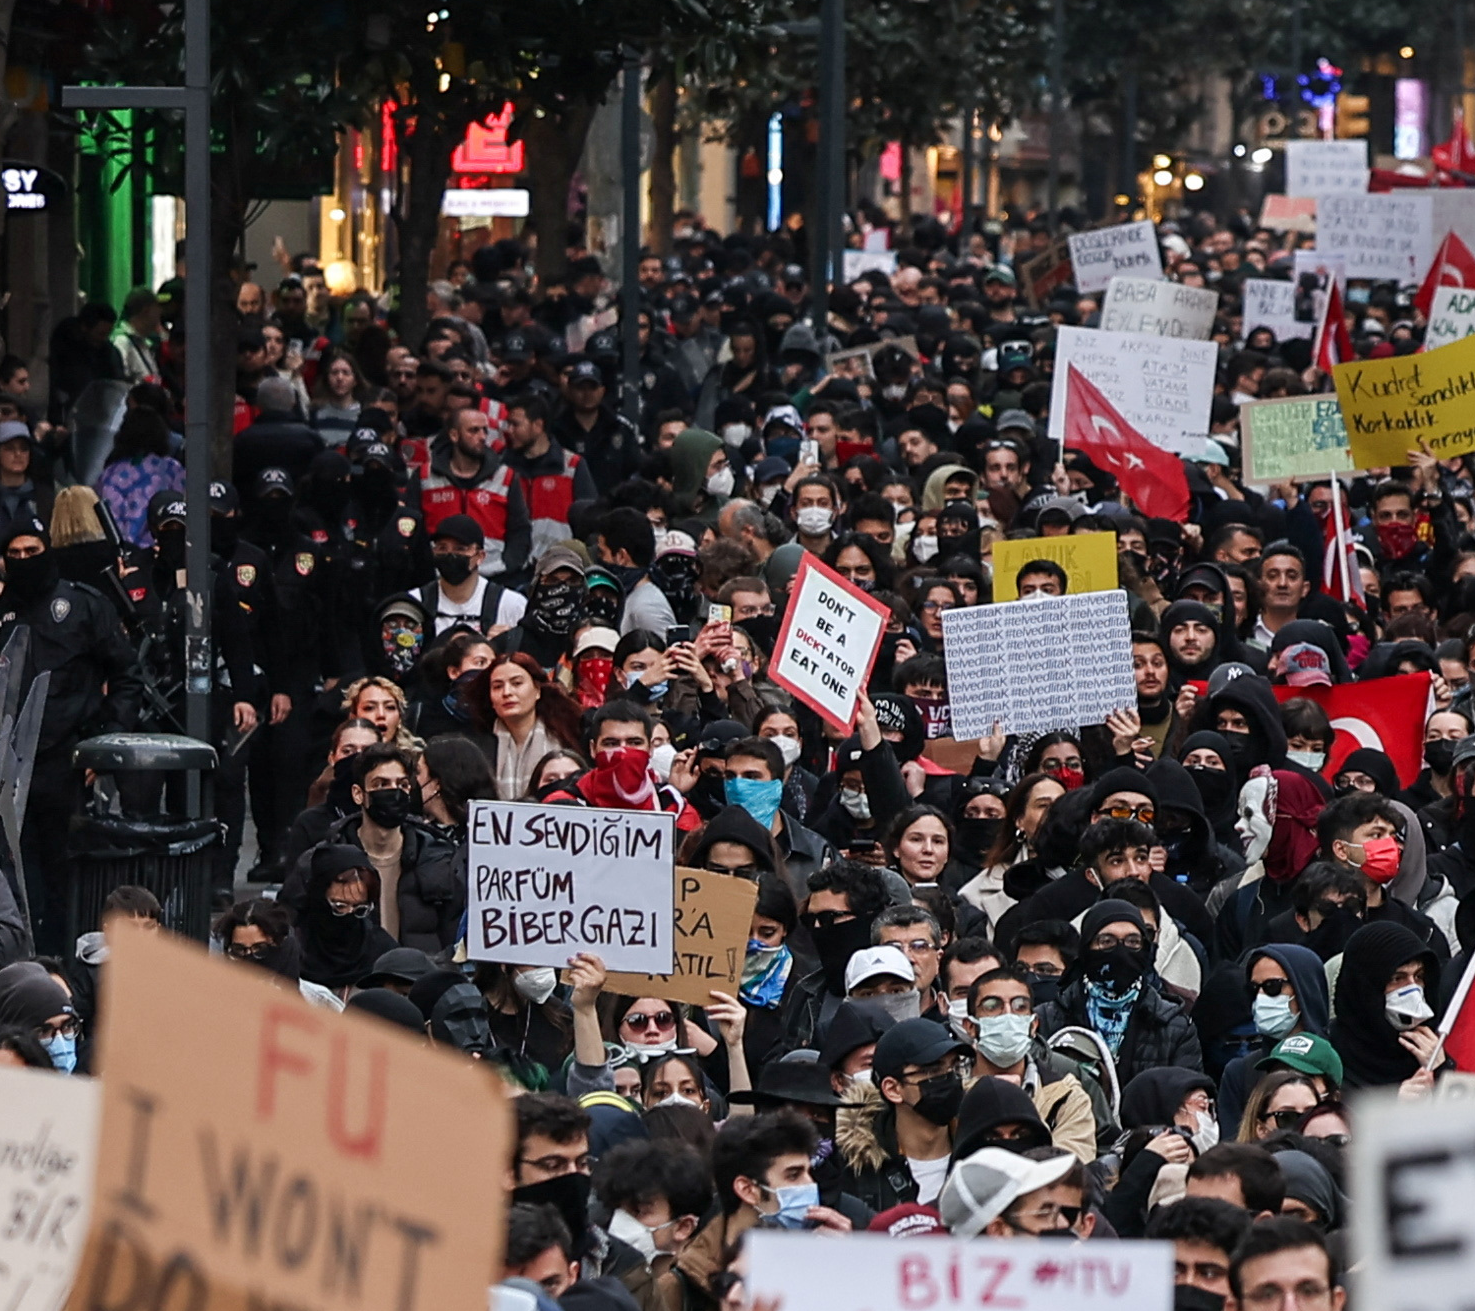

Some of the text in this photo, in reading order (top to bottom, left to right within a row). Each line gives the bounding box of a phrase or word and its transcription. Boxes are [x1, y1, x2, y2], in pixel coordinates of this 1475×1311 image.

[1347, 364, 1423, 403] Kudret
[1353, 409, 1438, 435] Korkaklık
[816, 617, 848, 649] BE A
[818, 591, 857, 624] DON'T
[790, 647, 849, 701] EAT ONE
[796, 627, 856, 678] DICKTATOR
[473, 806, 663, 860] EN SEVDİĞİM
[476, 864, 575, 905] PARFÜM
[254, 1000, 390, 1165] FU
[111, 1083, 162, 1222] I
[897, 1255, 1028, 1311] BİZ
